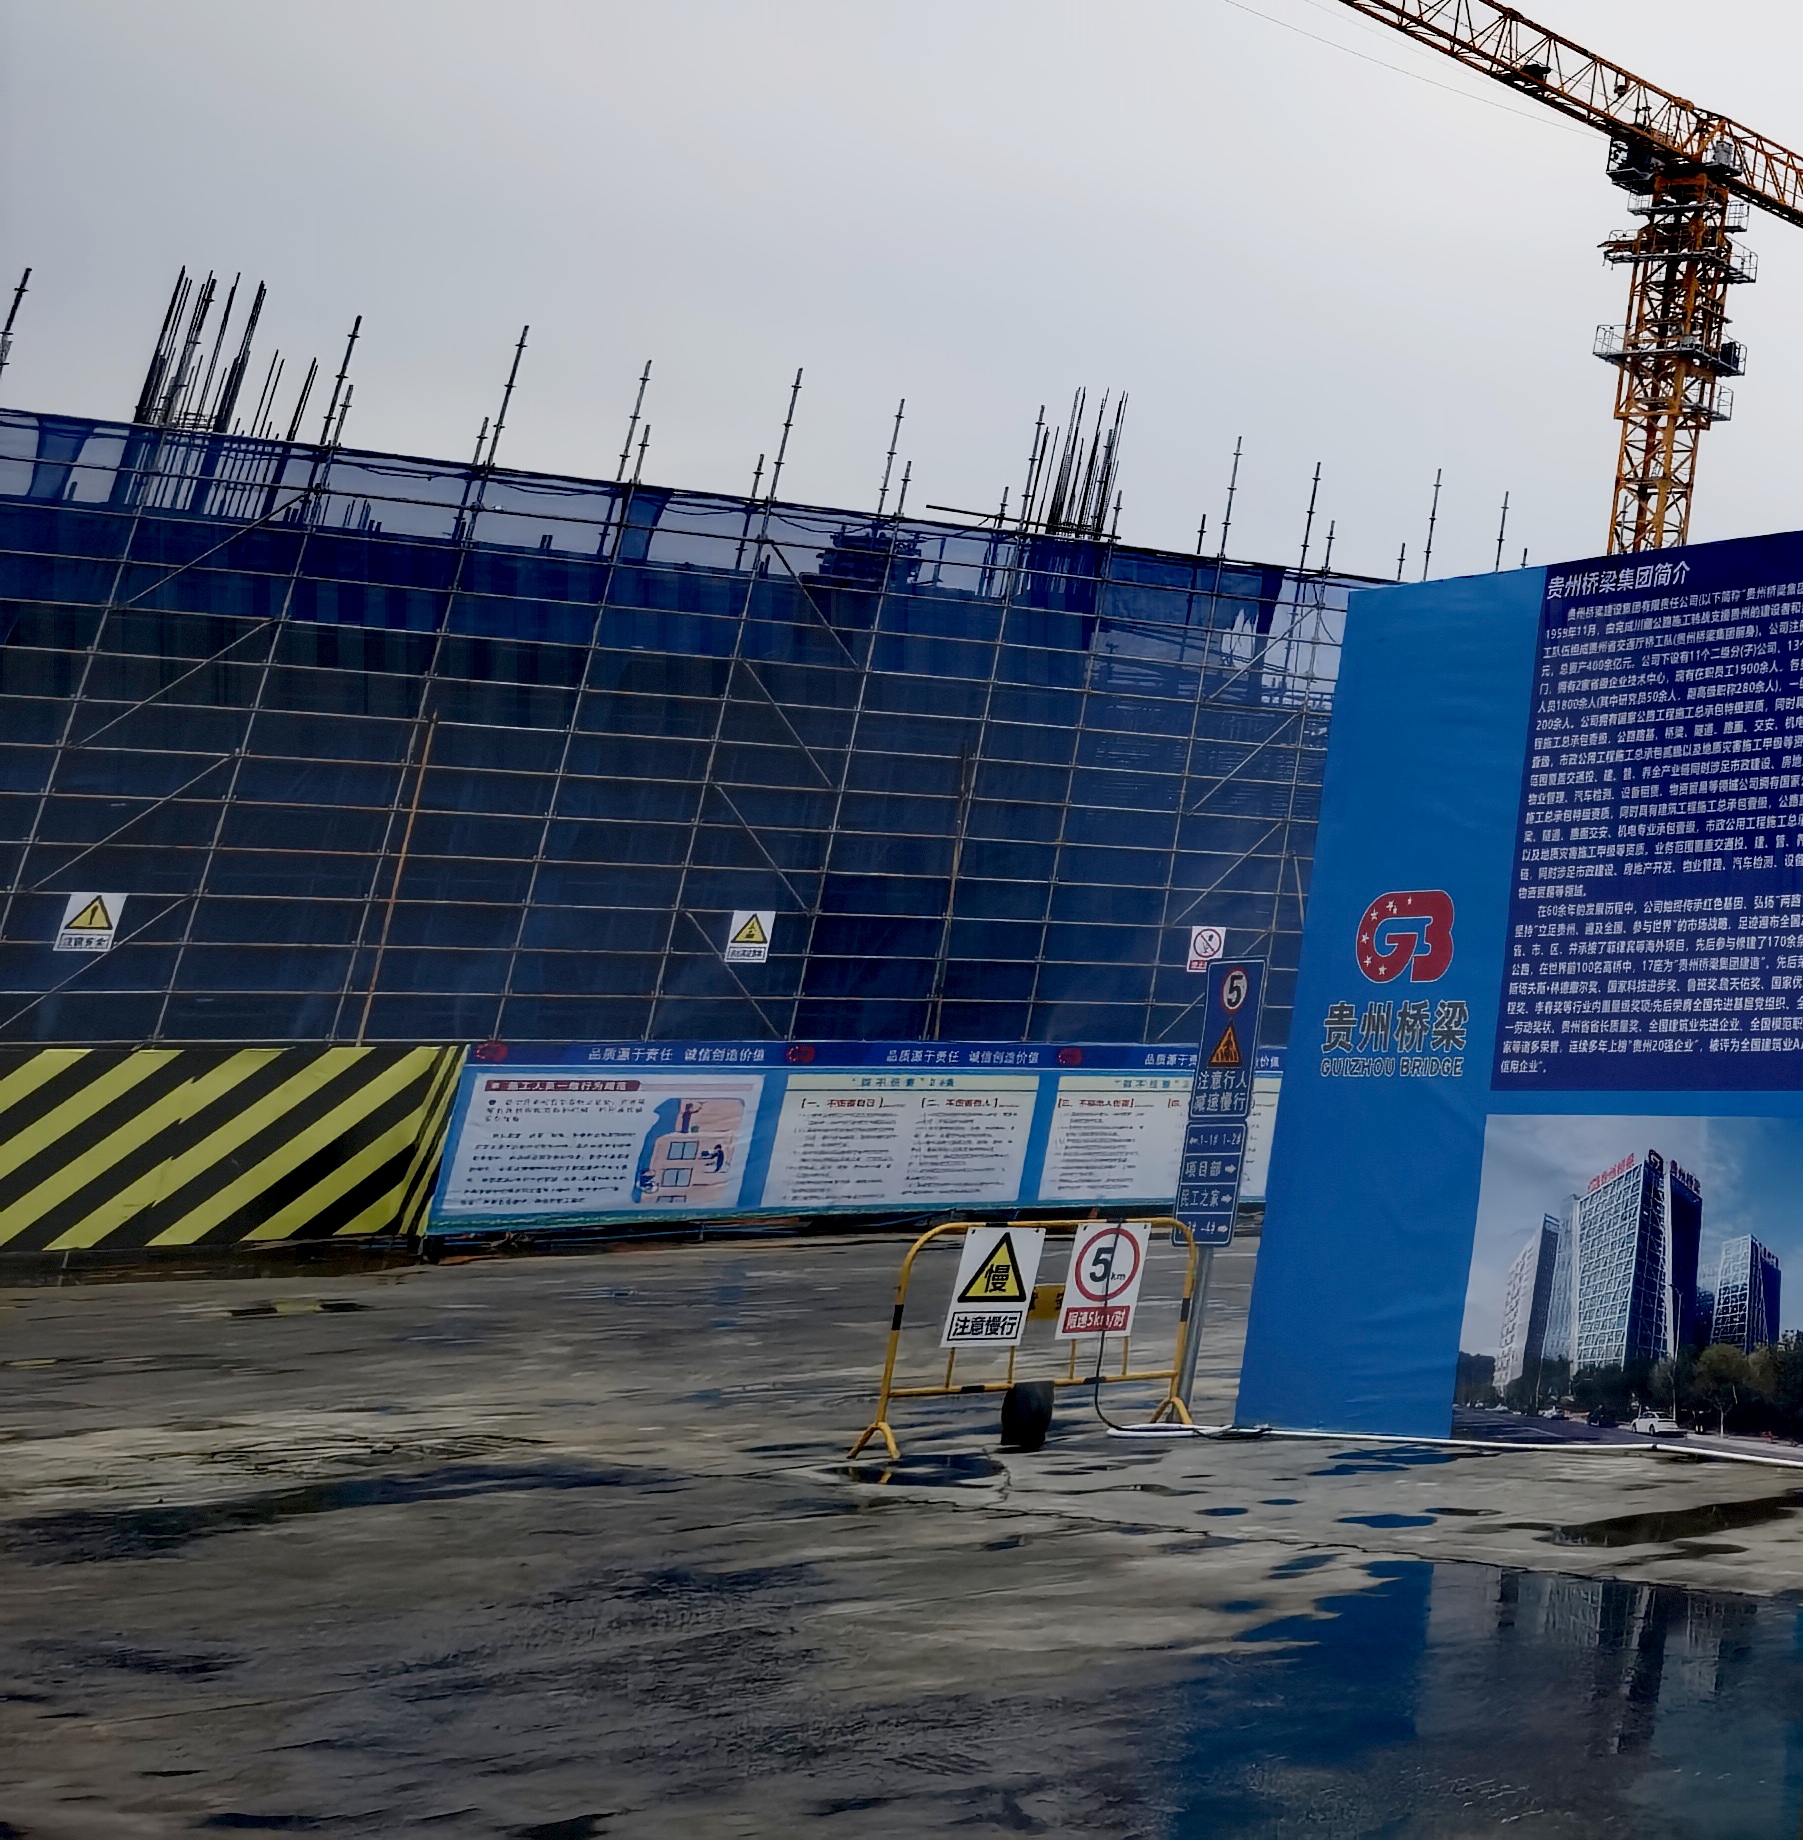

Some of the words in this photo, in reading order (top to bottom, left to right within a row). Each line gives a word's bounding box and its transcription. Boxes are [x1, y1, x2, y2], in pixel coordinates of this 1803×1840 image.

[1546, 559, 1690, 600] 贵州桥梁集团简介
[1355, 889, 1455, 984] GB
[1227, 974, 1242, 1006] 5
[1321, 999, 1469, 1054] 贵州桥梁
[588, 1048, 673, 1061] 品质源于责任
[684, 1048, 765, 1061] 诚信创造价值
[886, 1050, 959, 1063] 品质源于责任
[969, 1050, 1039, 1064] 诚信创造价值
[1145, 1054, 1198, 1066] 品质源于责
[1320, 1057, 1396, 1078] GUIZHOU
[1400, 1057, 1464, 1078] BRIDGE
[1198, 1071, 1247, 1090] 注意行人
[1184, 1161, 1222, 1177] 项目部
[1180, 1189, 1220, 1207] 民工之家
[1089, 1247, 1114, 1282] 5
[984, 1264, 1010, 1293] 慢
[953, 1315, 1018, 1337] 注意慢行
